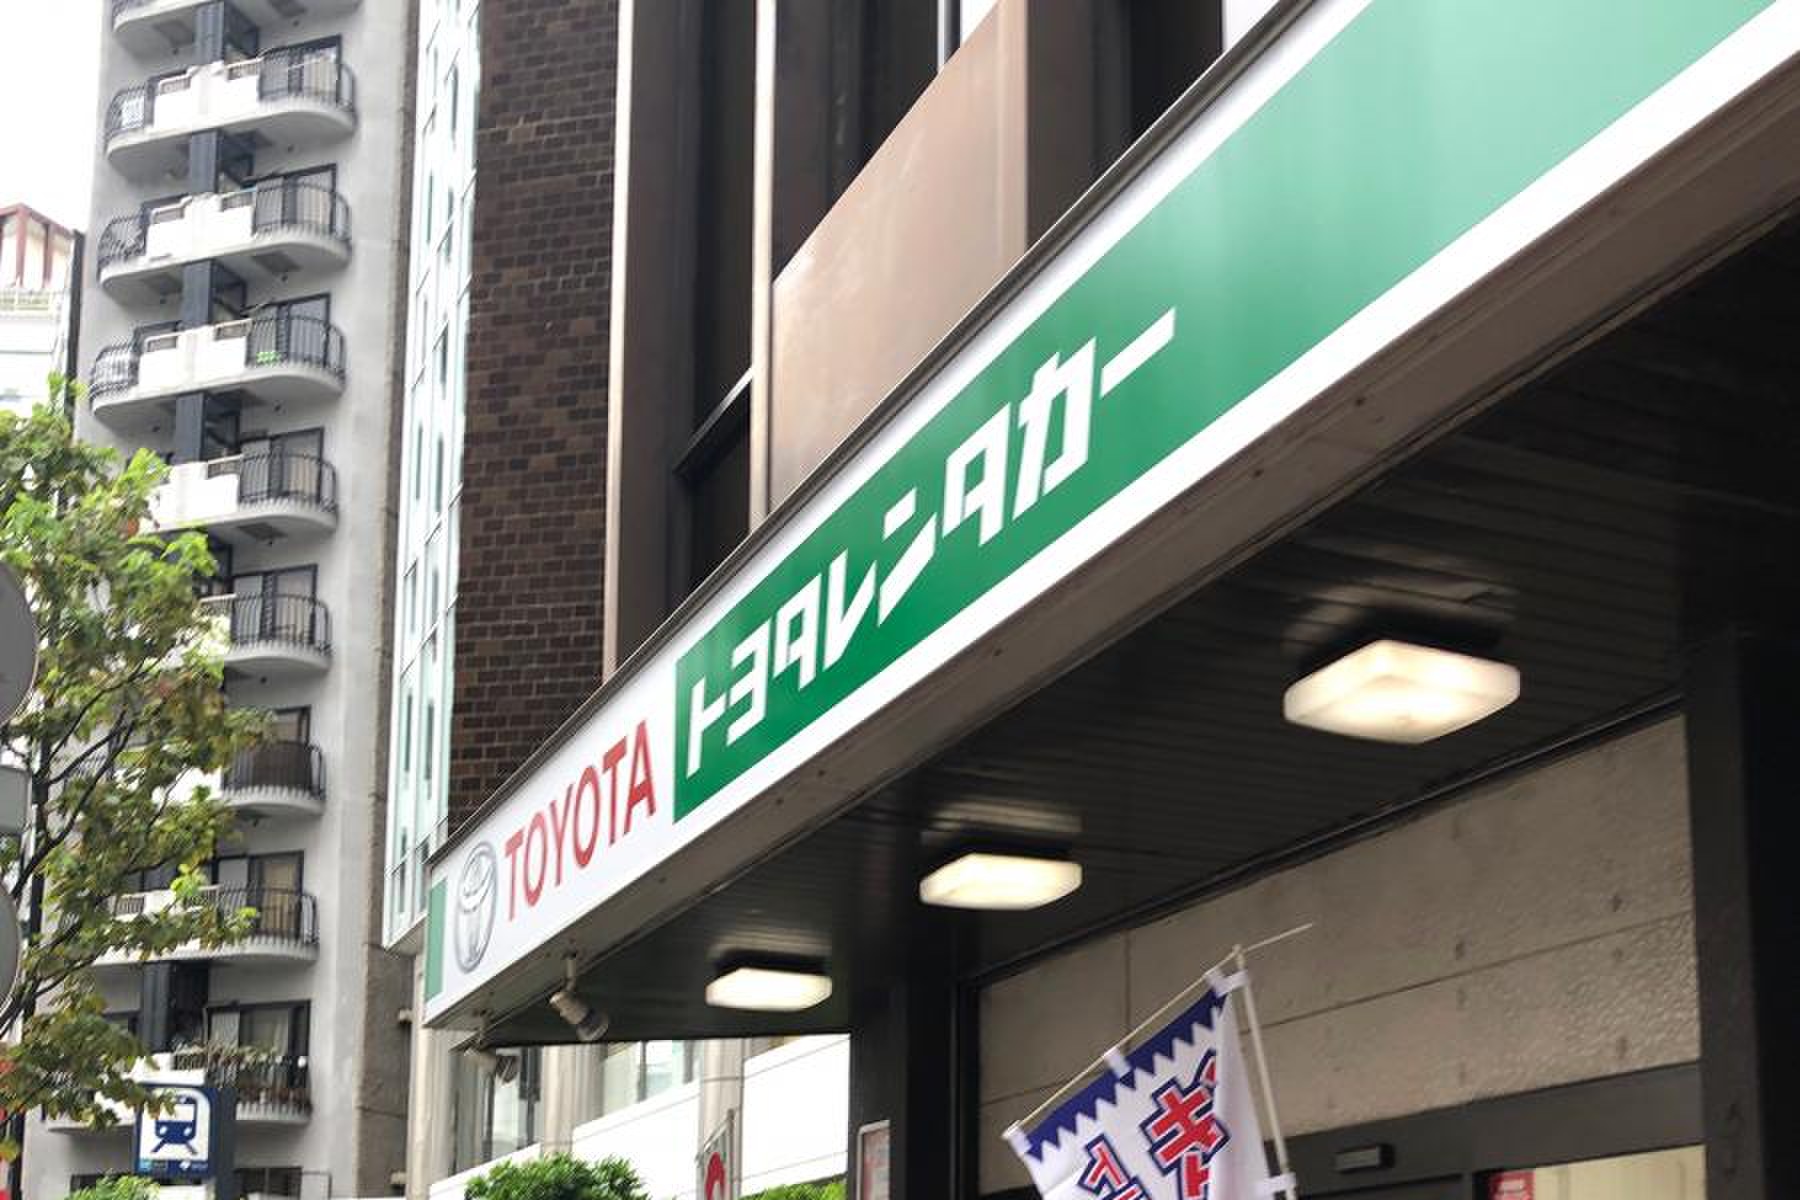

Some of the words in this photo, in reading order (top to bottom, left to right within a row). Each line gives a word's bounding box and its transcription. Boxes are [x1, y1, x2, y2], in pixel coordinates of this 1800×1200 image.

[685, 307, 1177, 777] トヨタレンタカー
[503, 719, 657, 922] TOYOTA
